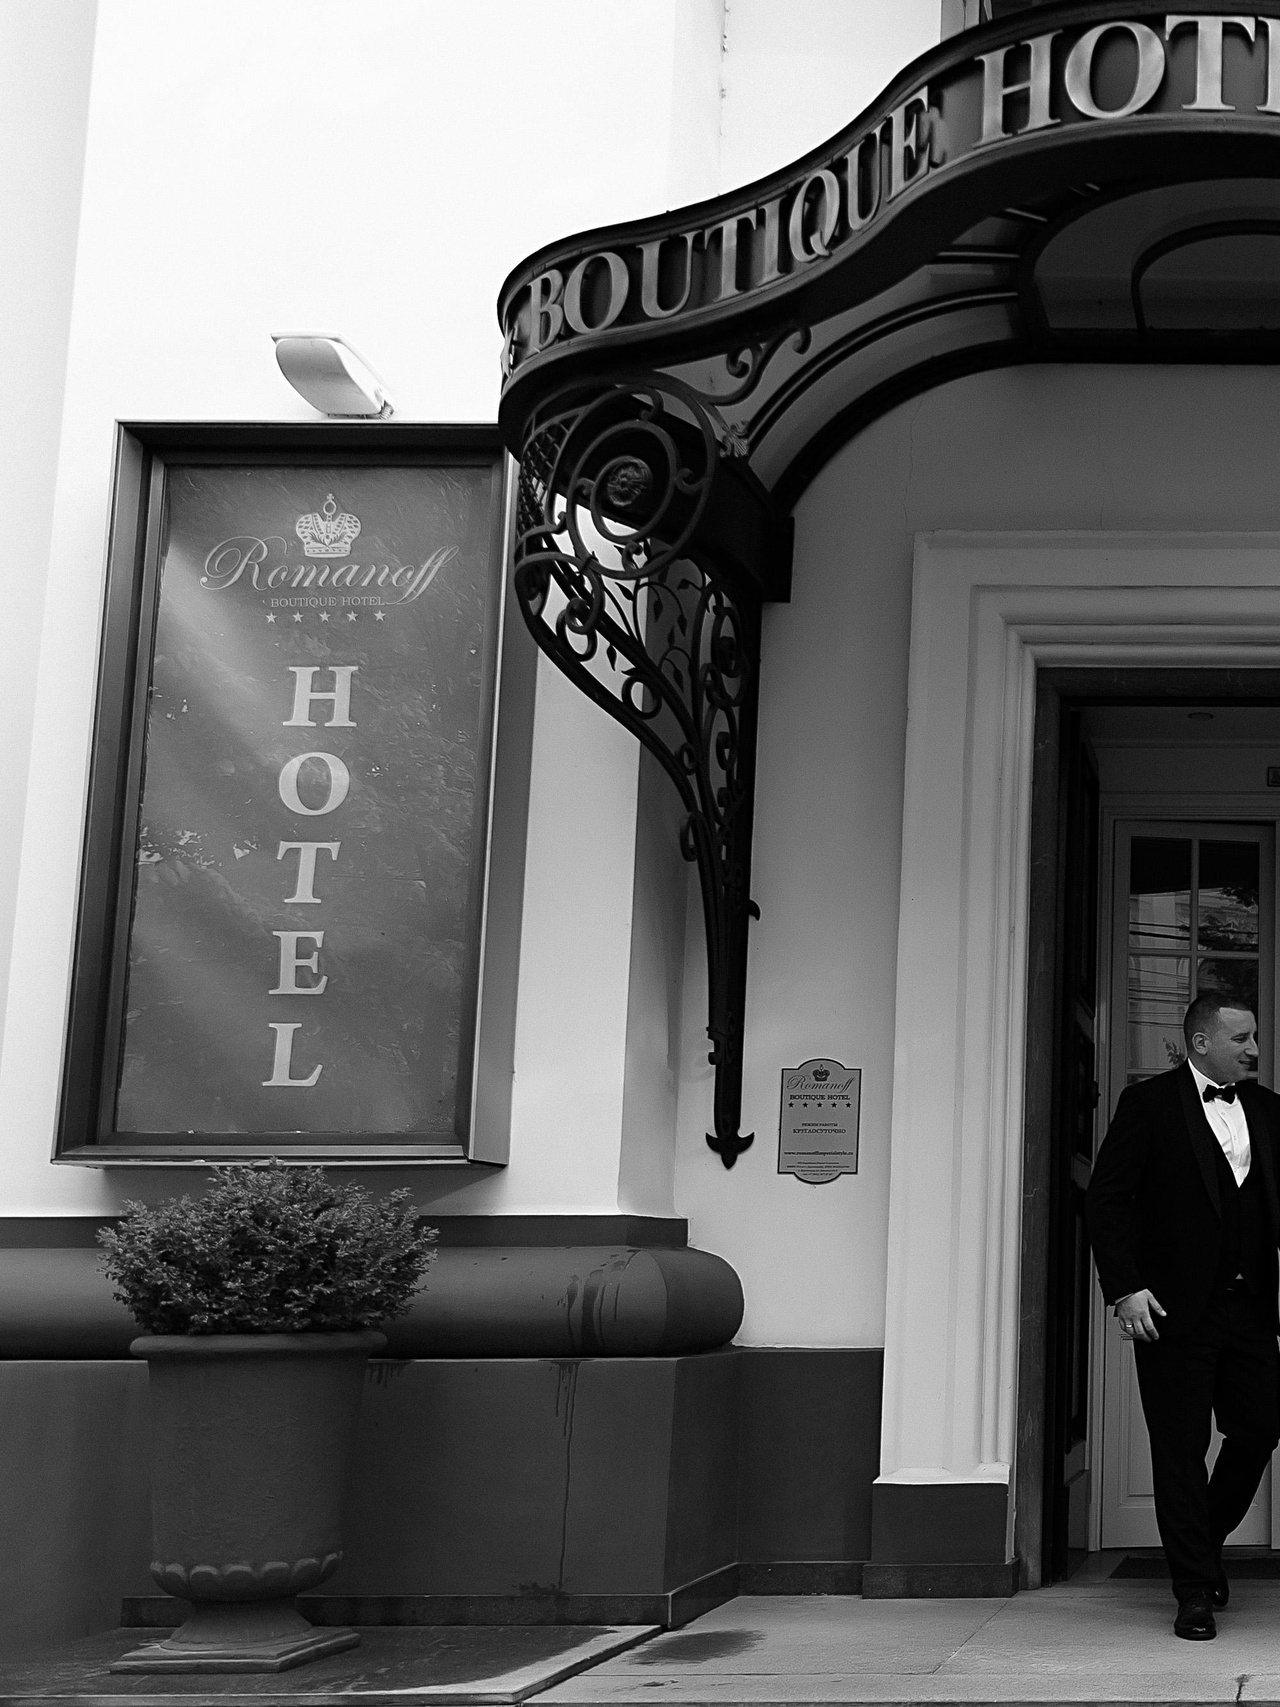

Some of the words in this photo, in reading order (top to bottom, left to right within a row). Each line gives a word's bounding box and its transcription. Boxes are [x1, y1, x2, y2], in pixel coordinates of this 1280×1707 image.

[526, 85, 934, 359] BOUTIQUE
[199, 535, 460, 605] Romanoff
[270, 596, 337, 608] BOUTIQUE
[341, 596, 386, 607] HOTEL
[261, 665, 359, 1087] HOTEL
[786, 1074, 856, 1094] Romanoff
